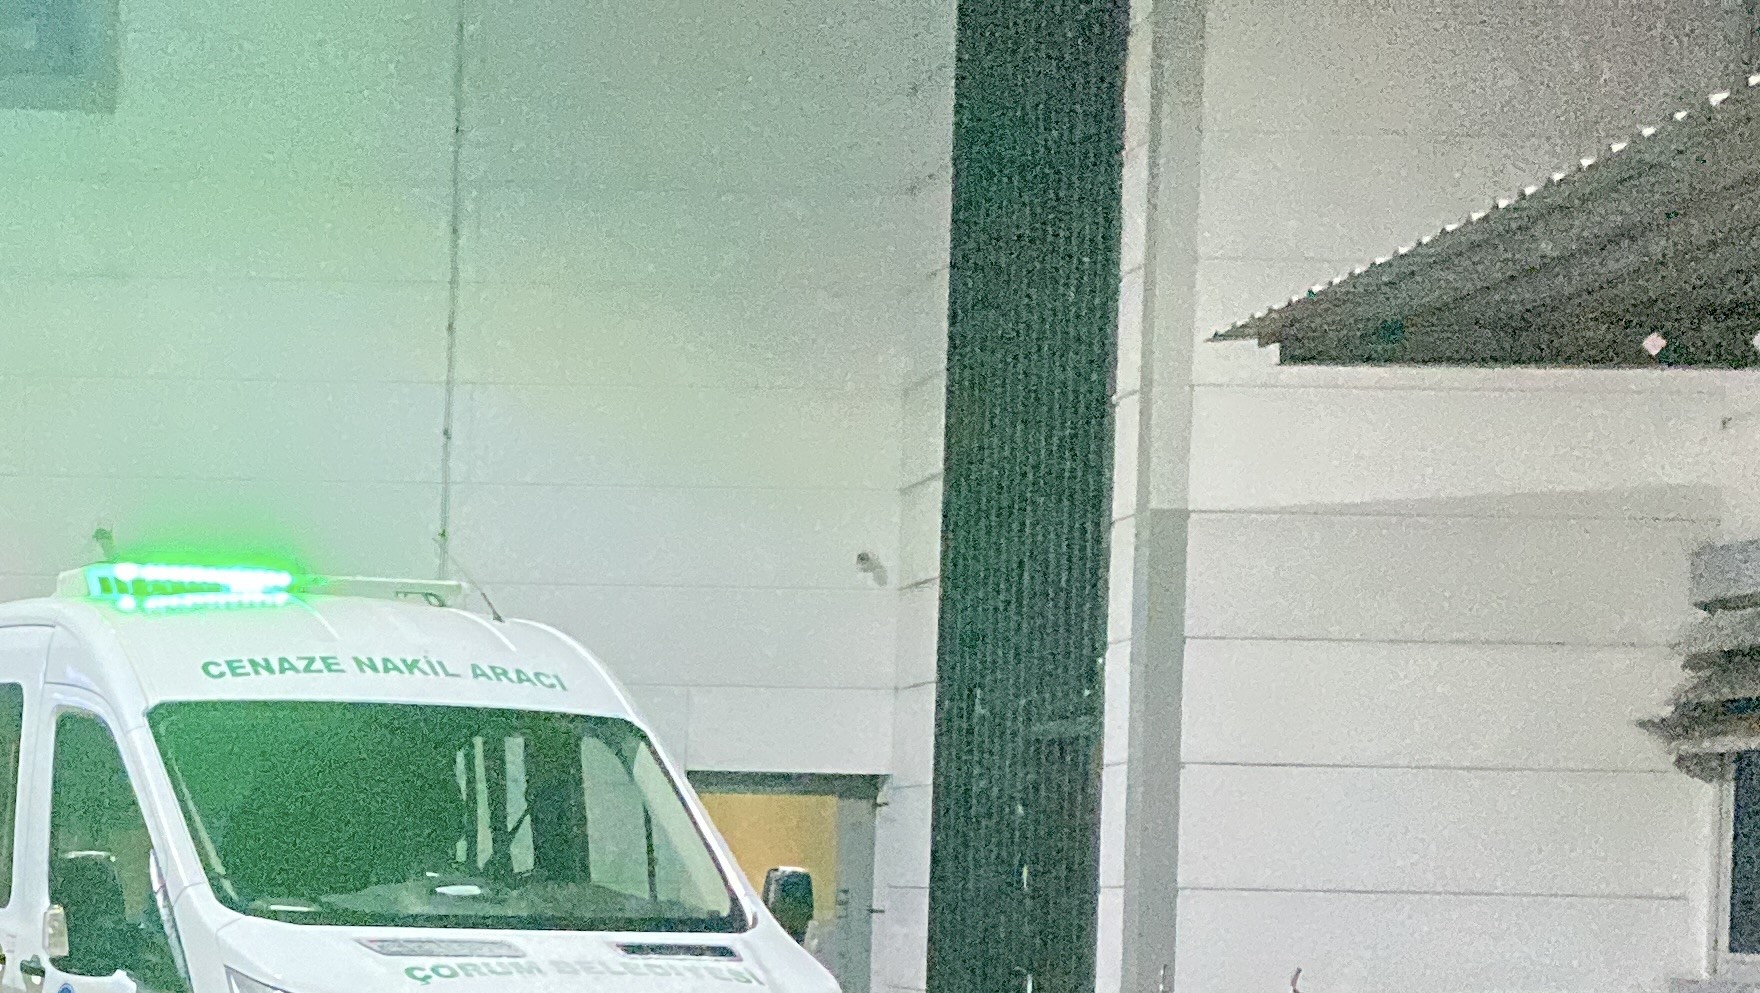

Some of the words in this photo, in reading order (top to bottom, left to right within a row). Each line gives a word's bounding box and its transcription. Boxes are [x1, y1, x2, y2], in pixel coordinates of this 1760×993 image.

[201, 656, 345, 679] CENAZE
[351, 651, 461, 679] NAKİL
[469, 663, 568, 691] ARACI
[404, 960, 543, 986] ÇORUM
